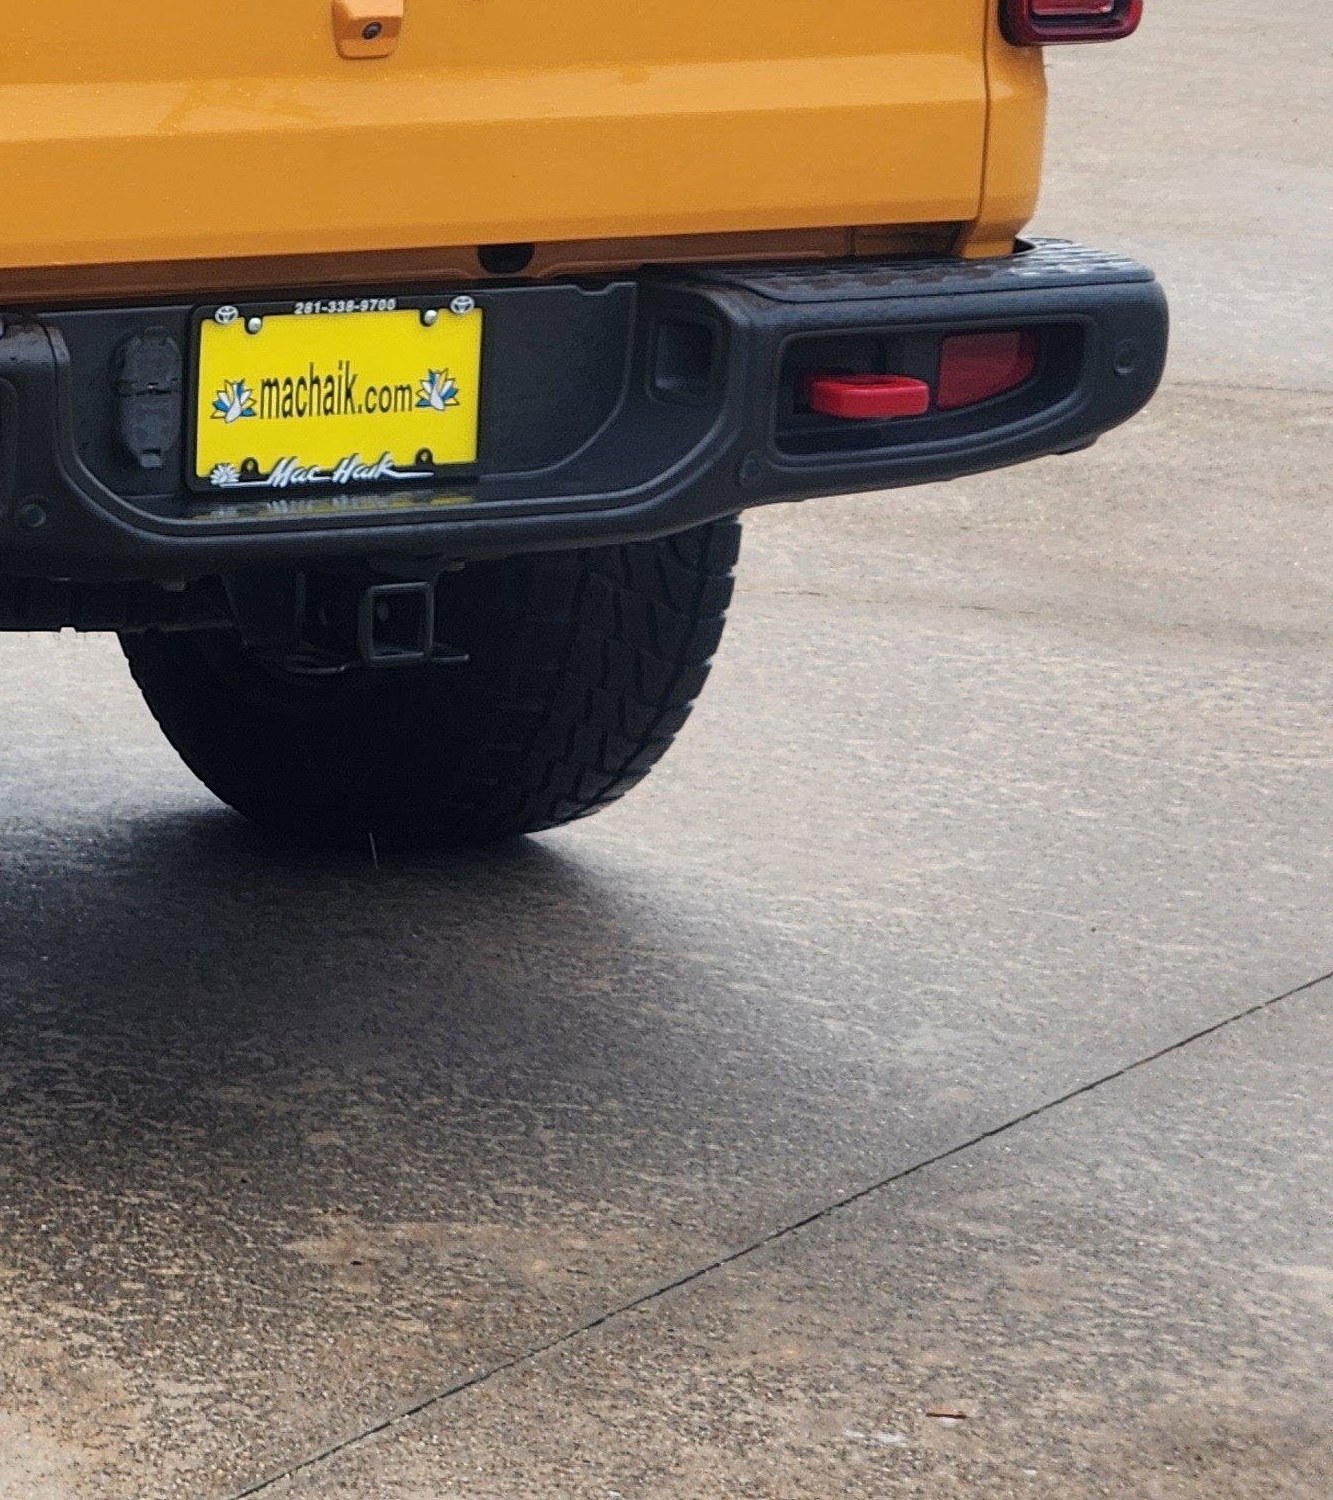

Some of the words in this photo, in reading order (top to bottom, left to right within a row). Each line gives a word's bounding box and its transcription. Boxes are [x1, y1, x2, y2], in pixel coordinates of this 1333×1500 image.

[260, 360, 413, 420] machaik.com
[265, 455, 331, 488] Mac
[332, 451, 408, 485] Haik
